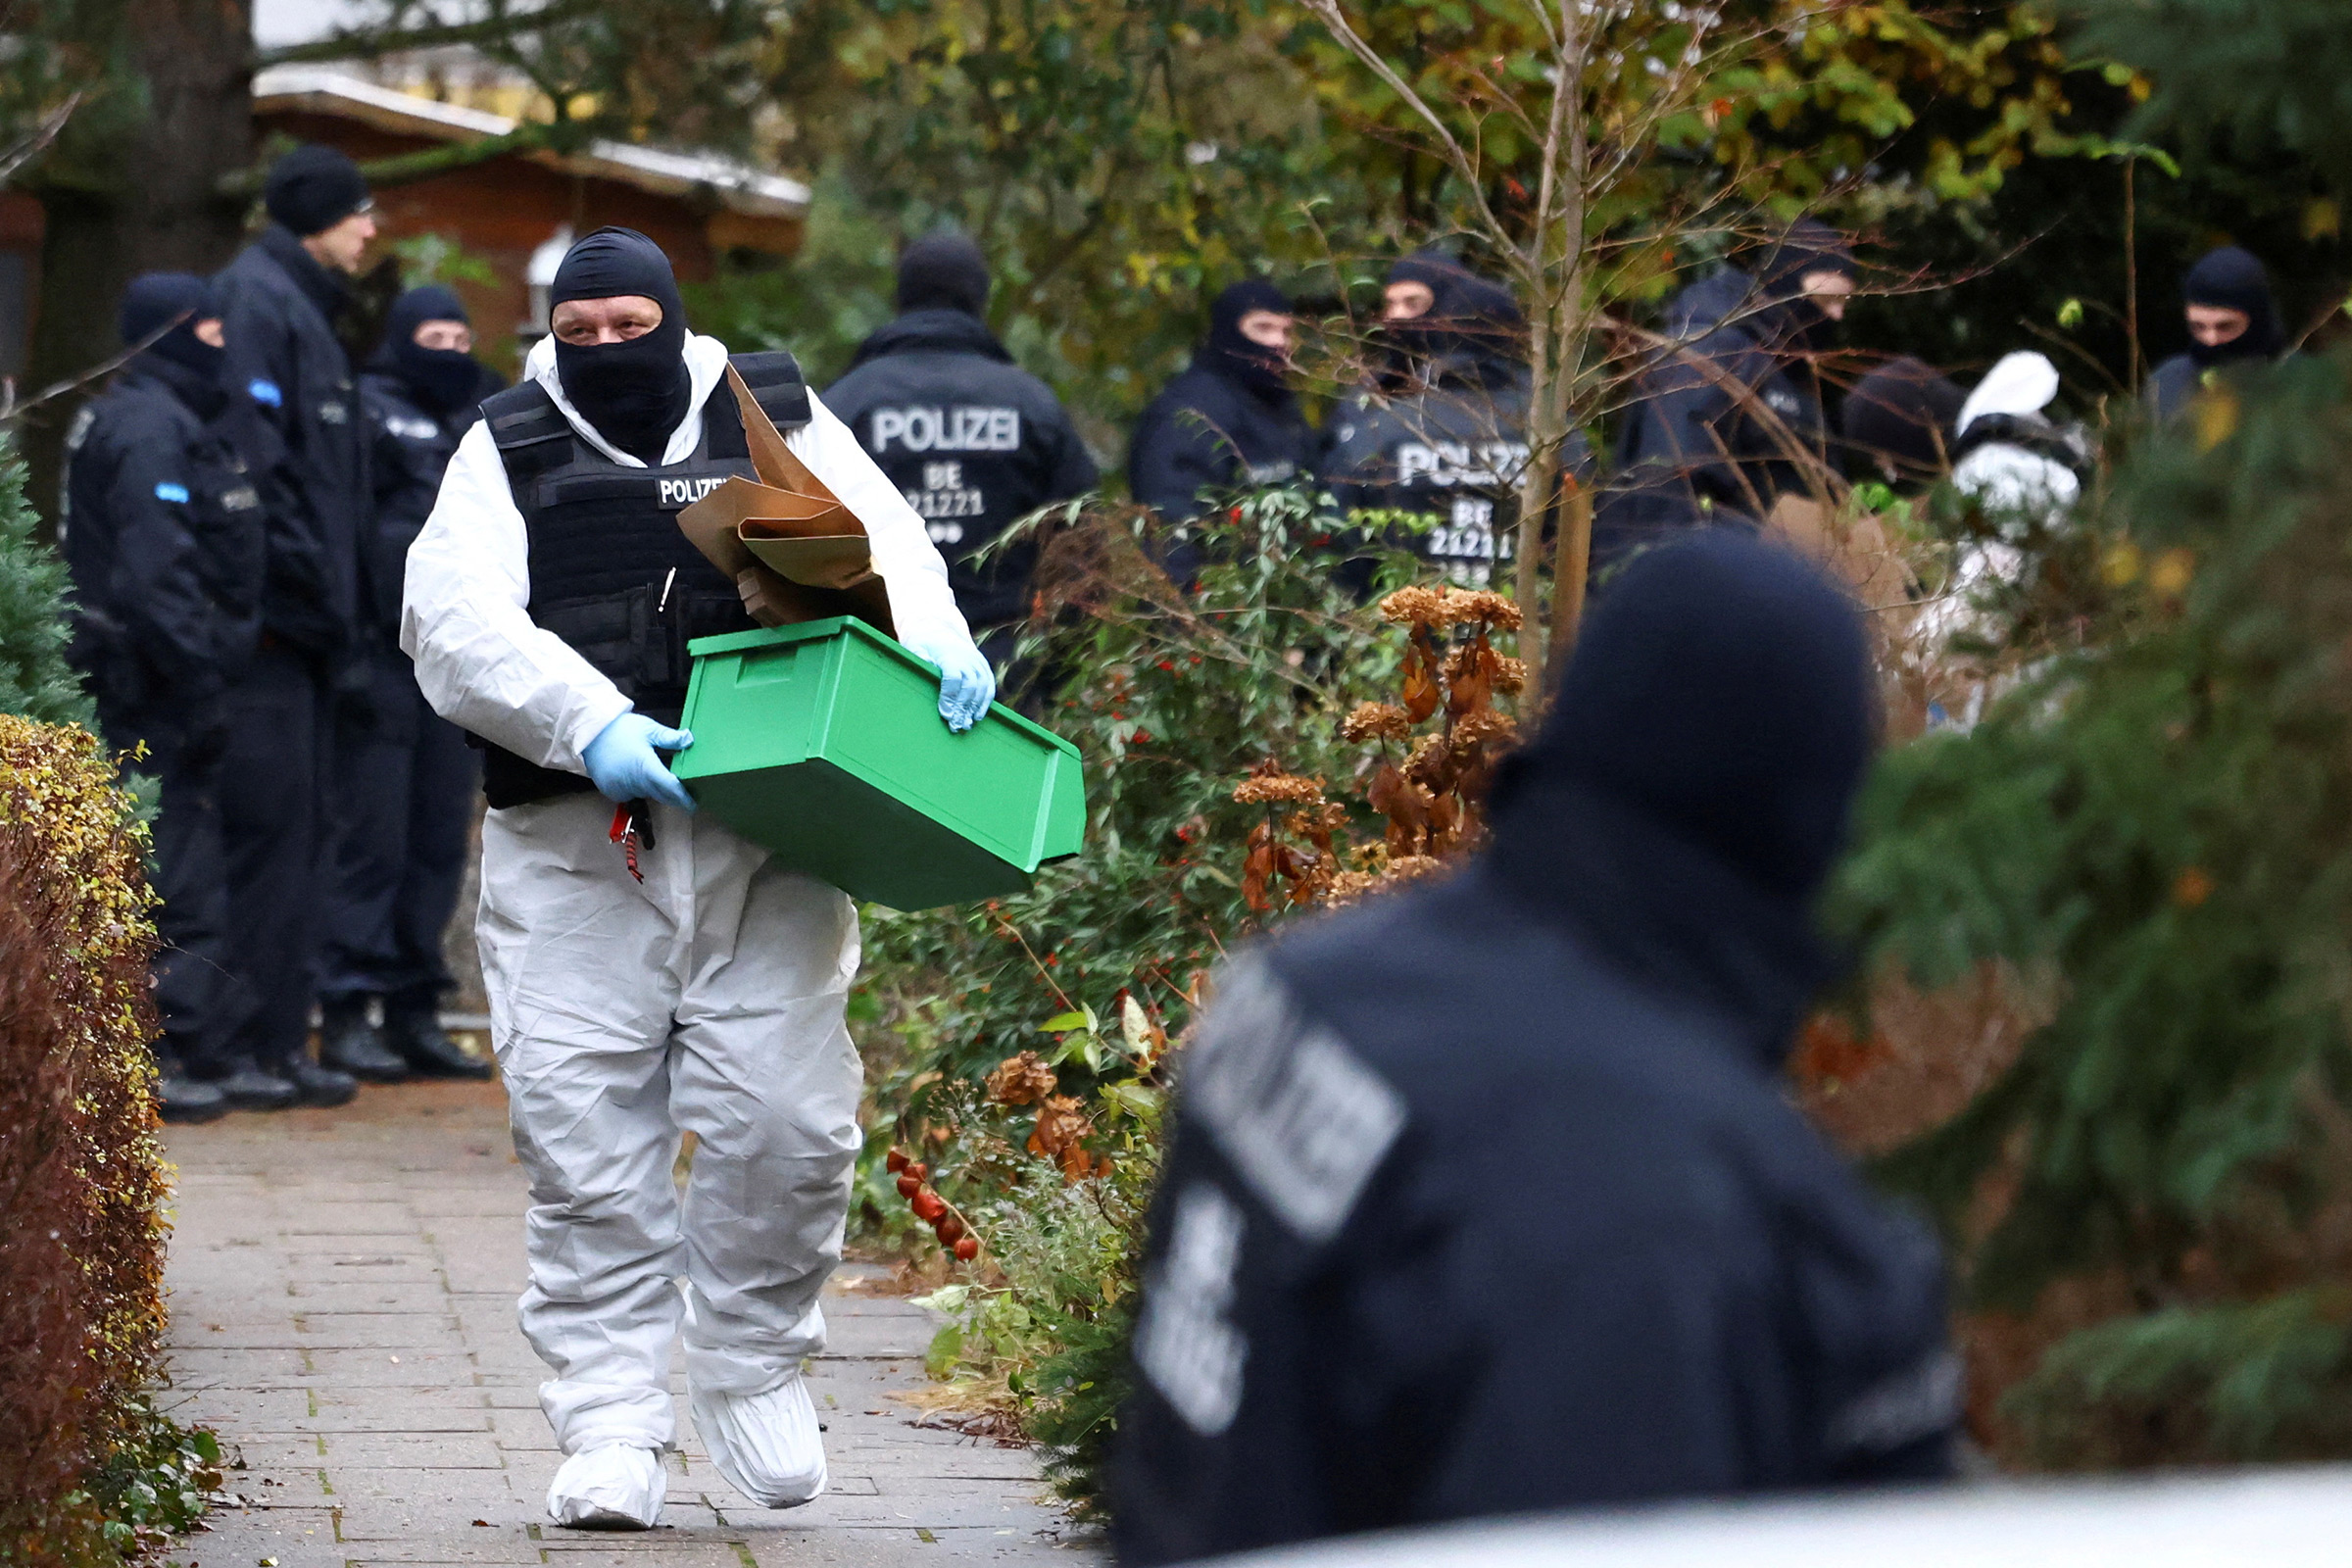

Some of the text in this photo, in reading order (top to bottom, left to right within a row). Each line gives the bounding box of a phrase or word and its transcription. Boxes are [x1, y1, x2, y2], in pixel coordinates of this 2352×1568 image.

[872, 407, 1020, 452] POLIZEI
[660, 477, 727, 503] POLIZ
[923, 461, 962, 490] BE
